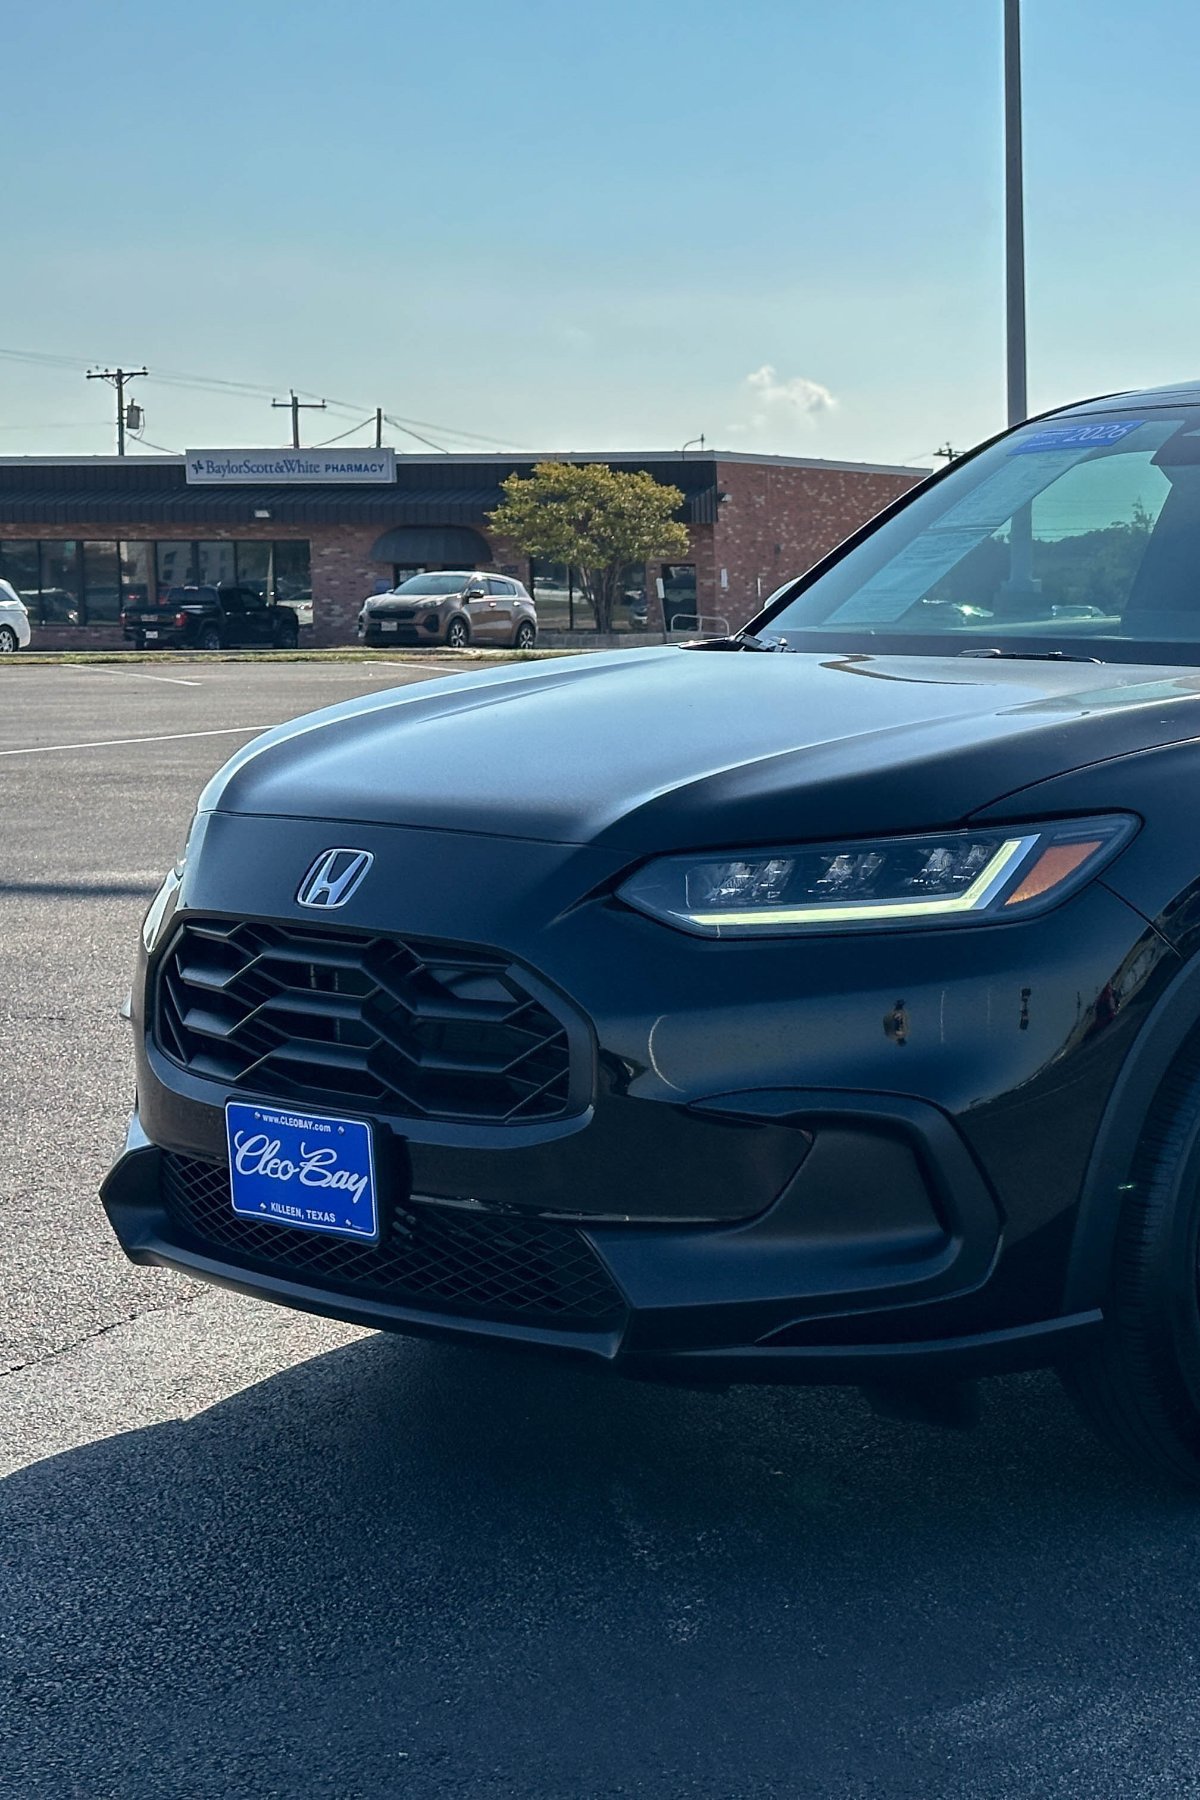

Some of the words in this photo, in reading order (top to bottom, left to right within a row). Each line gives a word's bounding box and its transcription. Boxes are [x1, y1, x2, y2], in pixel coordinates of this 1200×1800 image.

[1063, 424, 1133, 443] 2026
[325, 463, 385, 473] PHARMACY
[262, 1114, 331, 1133] www.CLEOBAY.com
[234, 1130, 300, 1181] Cleo
[299, 1142, 368, 1203] Bay
[270, 1202, 304, 1220] KILLEEN,
[305, 1209, 336, 1223] TEXAS
